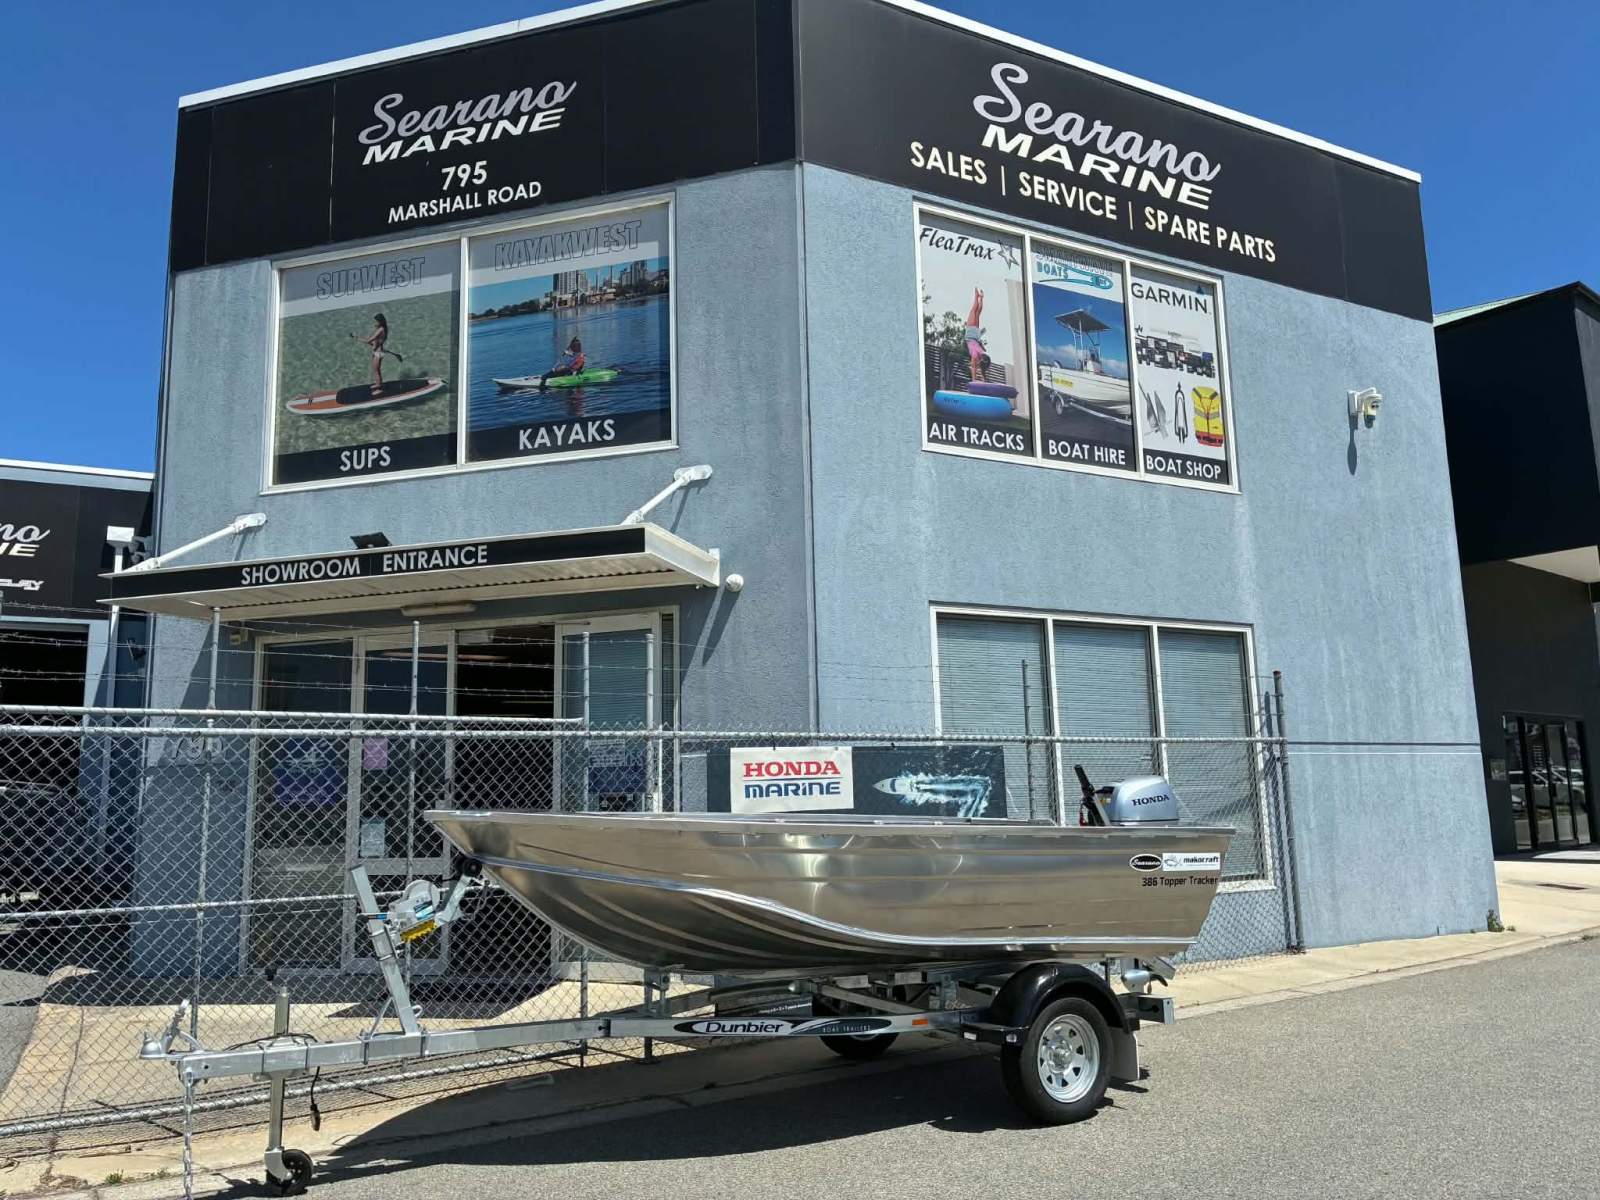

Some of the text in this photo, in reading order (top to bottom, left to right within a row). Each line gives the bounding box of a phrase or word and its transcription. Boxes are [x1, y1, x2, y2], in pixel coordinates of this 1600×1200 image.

[358, 81, 577, 145] Searano
[973, 62, 1221, 182] Searano
[362, 107, 566, 165] MARINE
[441, 160, 488, 191] 795
[981, 124, 1213, 210] MARINE
[388, 181, 542, 224] MARSHALL ROAD
[910, 141, 1276, 263] SALES SERVICE SPARE PARTS
[494, 220, 642, 271] KAYAKWEST
[919, 224, 997, 261] FleaTrax
[316, 256, 426, 300] SUPWEST
[1131, 282, 1208, 313] GARMIN
[519, 418, 616, 450] KAYAKS
[929, 422, 1025, 451] AIR TRACKS
[340, 446, 391, 472] SUPS
[1048, 439, 1126, 466] BOAT HIRE
[1146, 454, 1221, 480] BOAT SHOP
[241, 545, 488, 585] SHOWROOM ENTRANCE
[742, 760, 841, 778] HONDA
[744, 781, 841, 799] MARINE
[1132, 794, 1170, 806] HONDA
[1160, 876, 1187, 888] Topper
[1189, 875, 1219, 886] Tracker
[705, 1021, 784, 1034] Dunbier
